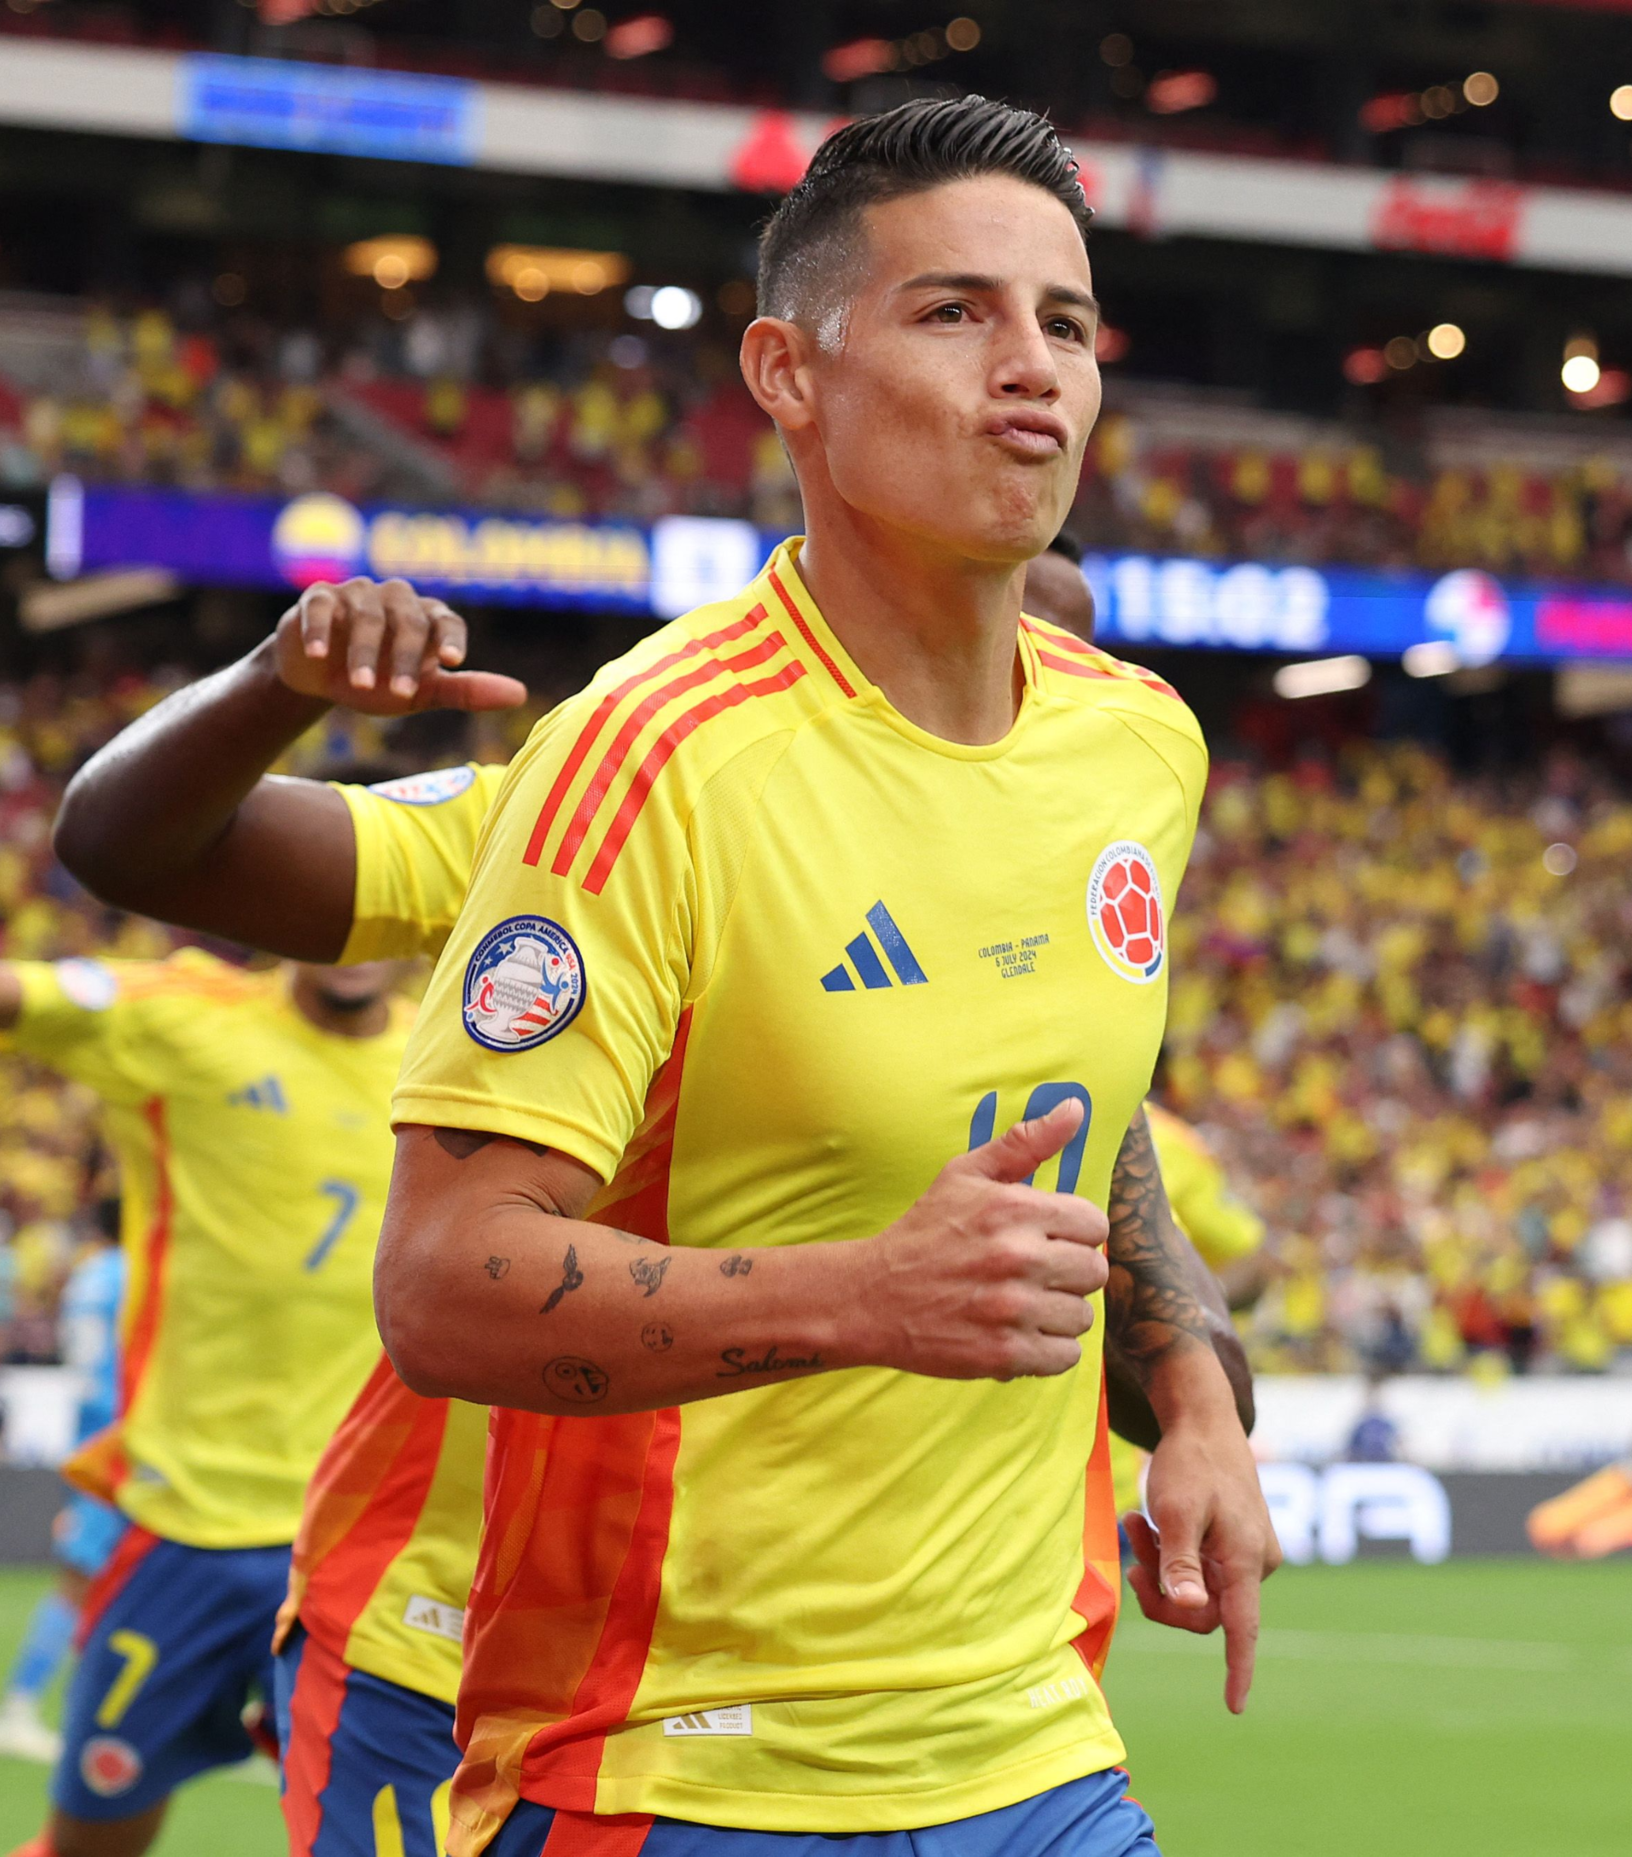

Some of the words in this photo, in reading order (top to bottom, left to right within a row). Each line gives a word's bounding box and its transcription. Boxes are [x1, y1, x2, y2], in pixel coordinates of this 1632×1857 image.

[475, 926, 514, 962] CONMEBOL
[514, 922, 536, 932] COPA
[538, 926, 570, 953] AMERICA
[978, 941, 1013, 958] COLOMBIA
[1021, 933, 1050, 949] PANAMA
[1002, 953, 1017, 966] JULY
[1019, 950, 1037, 962] 2024
[1001, 961, 1035, 979] GLENDALE
[304, 1178, 360, 1272] 7
[94, 1629, 159, 1729] 7
